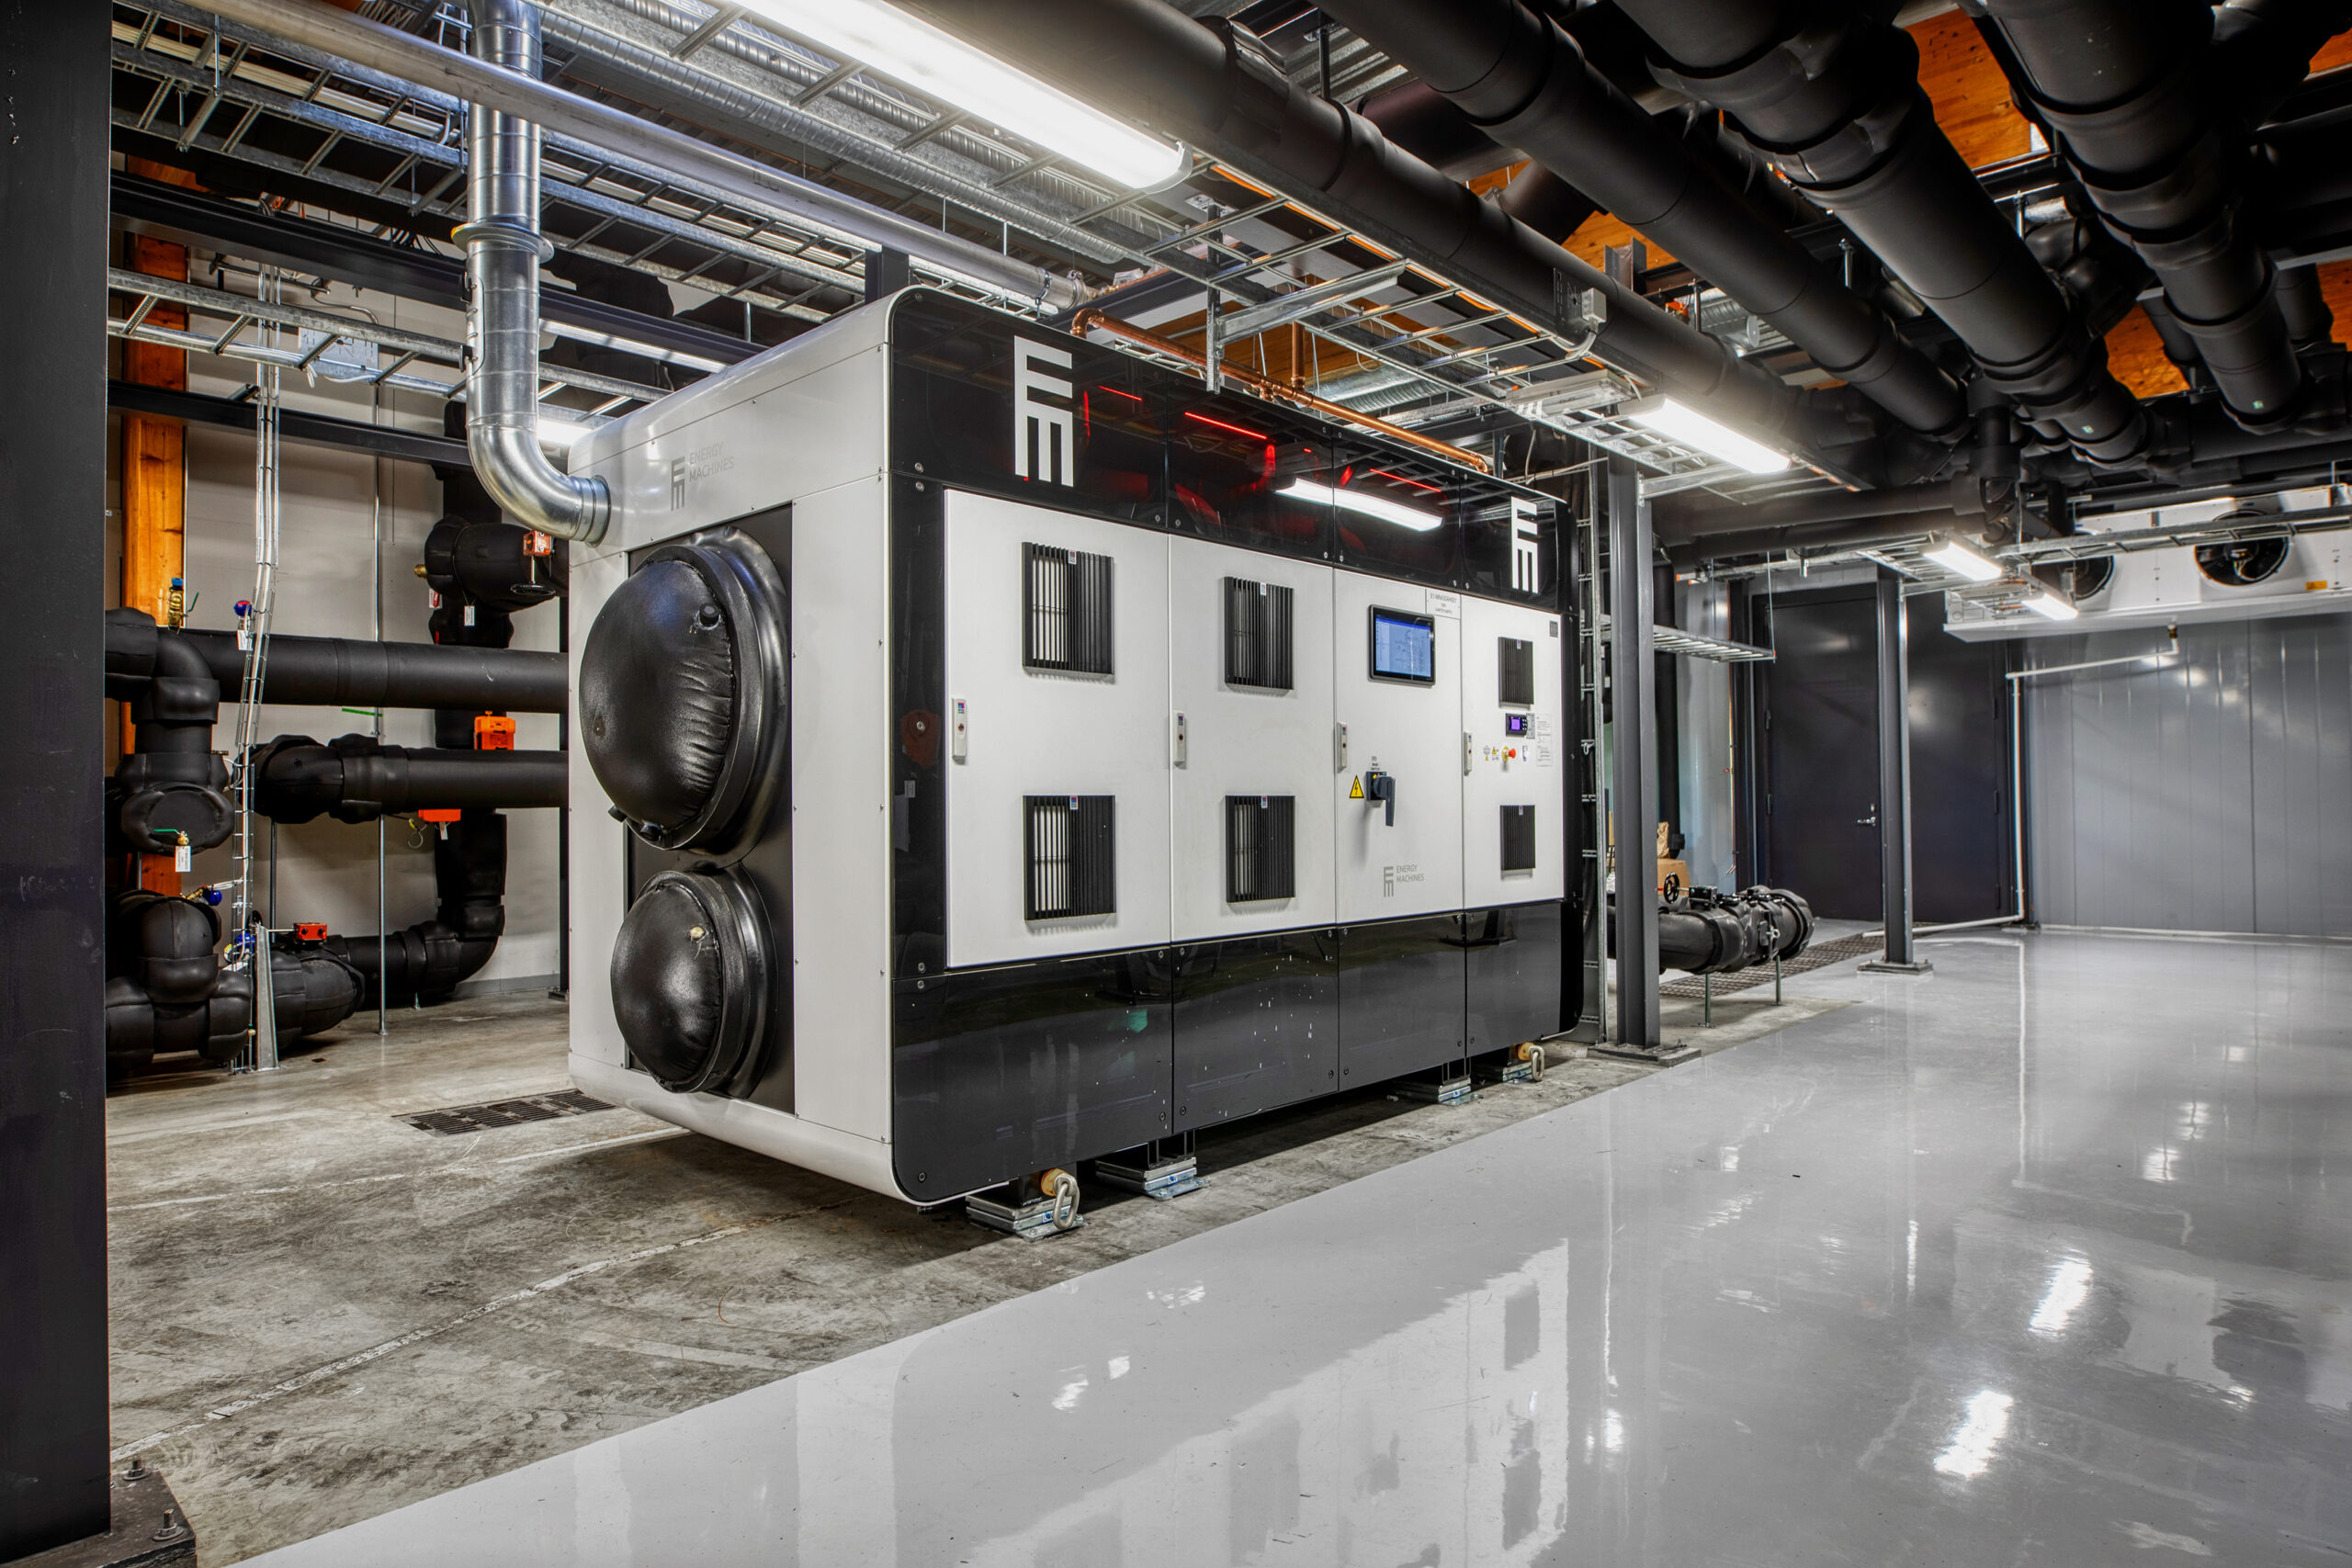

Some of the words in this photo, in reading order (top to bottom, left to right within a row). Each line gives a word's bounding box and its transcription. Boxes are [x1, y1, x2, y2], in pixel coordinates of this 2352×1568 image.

[689, 440, 724, 465] ENERGY
[689, 456, 735, 483] MACHINES
[1396, 863, 1418, 874] ENERGY
[1396, 874, 1425, 883] MACHINES
